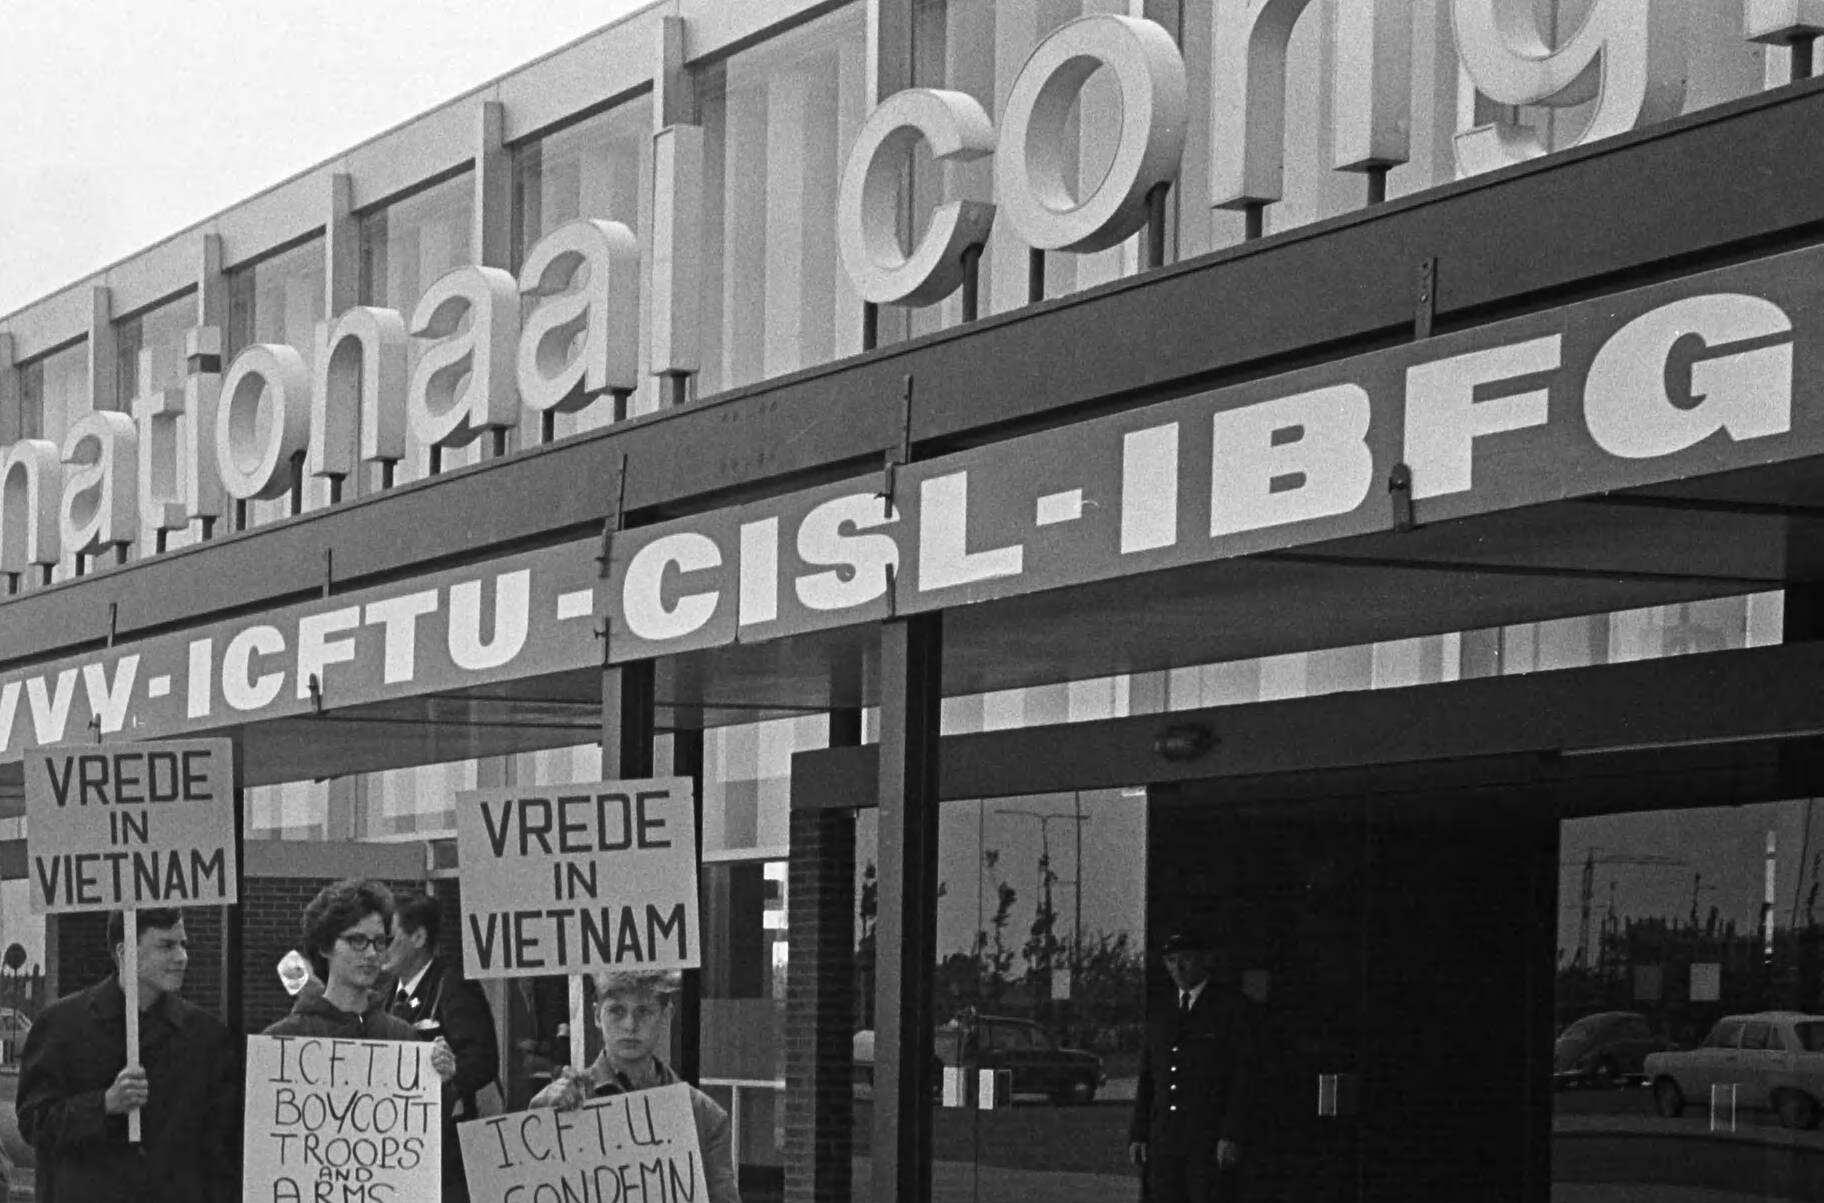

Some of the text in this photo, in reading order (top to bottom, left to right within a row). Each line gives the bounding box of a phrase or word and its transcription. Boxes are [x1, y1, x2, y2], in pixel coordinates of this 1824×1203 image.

[839, 0, 1824, 307] cong
[44, 750, 214, 807] VREDE
[110, 810, 149, 846] IN
[480, 790, 672, 858] VREDE
[35, 847, 227, 906] VIETNAM
[553, 861, 598, 901] IN
[469, 903, 688, 970] VIETNAM
[274, 1087, 438, 1134] BOYCOTT
[270, 1132, 425, 1170] TROOPS
[319, 1166, 373, 1182] AND
